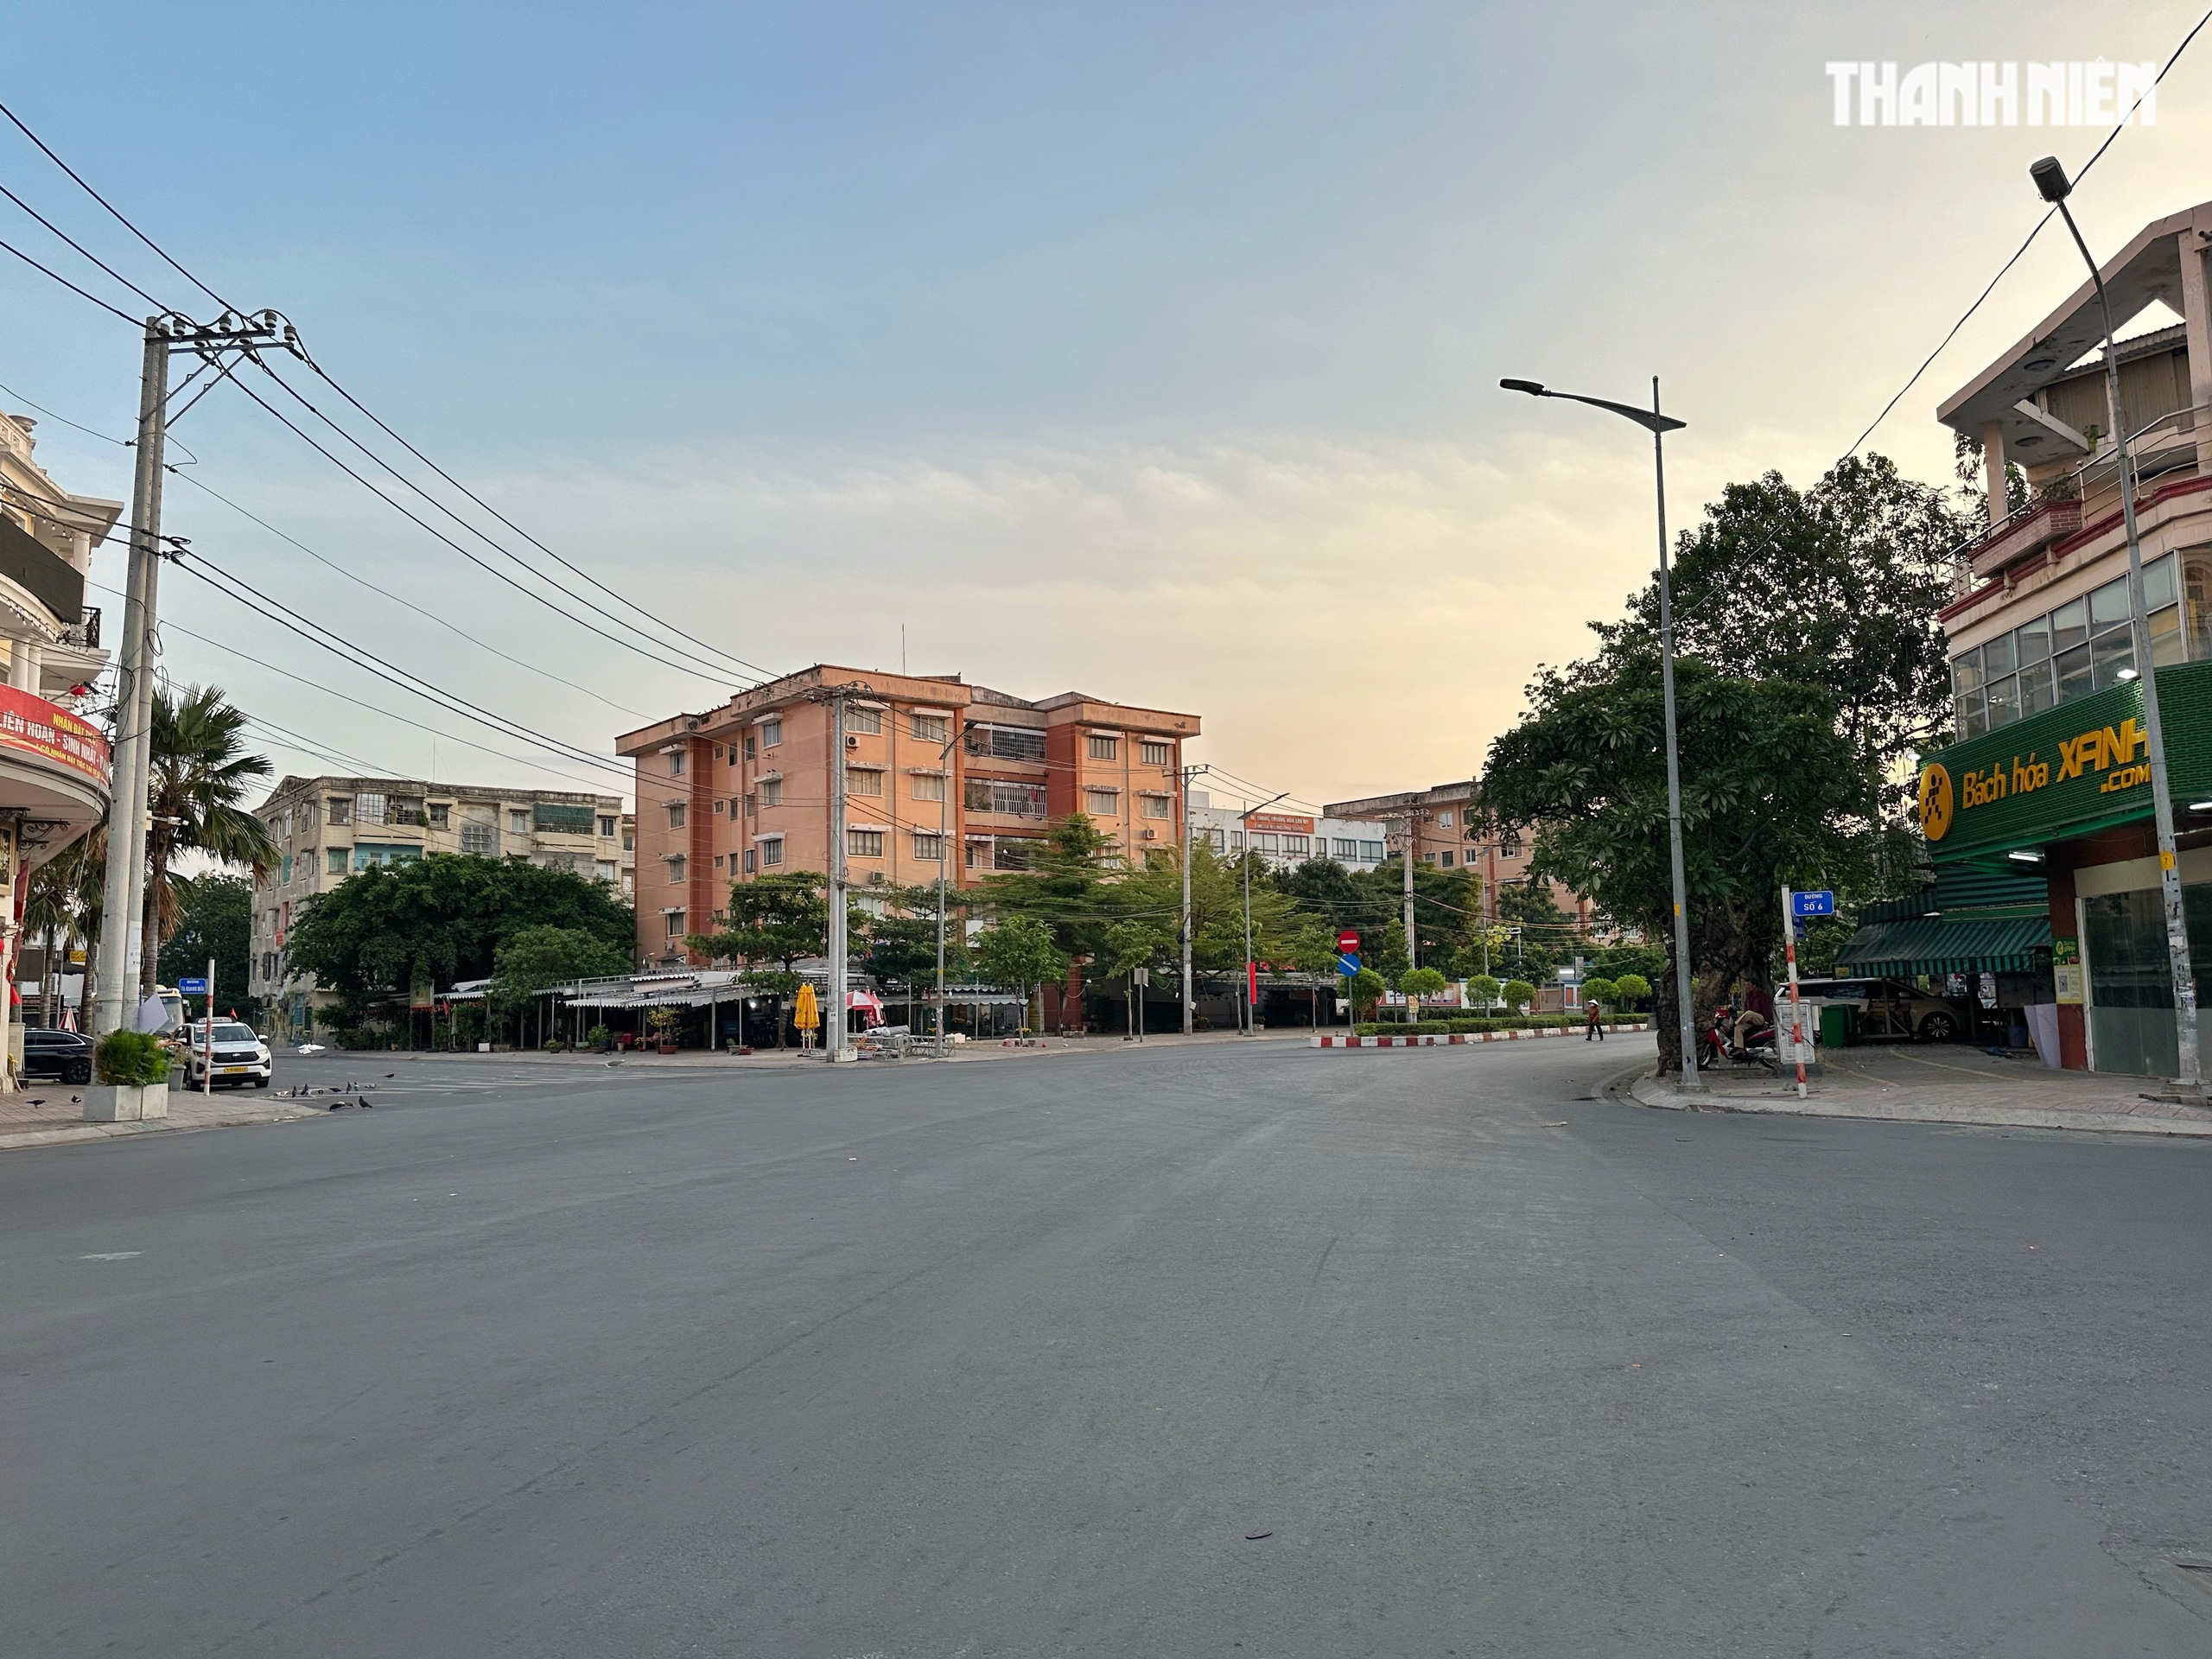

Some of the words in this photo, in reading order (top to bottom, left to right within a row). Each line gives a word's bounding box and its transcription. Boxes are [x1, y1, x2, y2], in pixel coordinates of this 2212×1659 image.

[62, 734, 80, 756] SINH
[1962, 762, 2006, 810] Bách
[2012, 752, 2050, 795] hóa
[2056, 717, 2150, 783] XANH
[1803, 900, 1816, 911] SỐ
